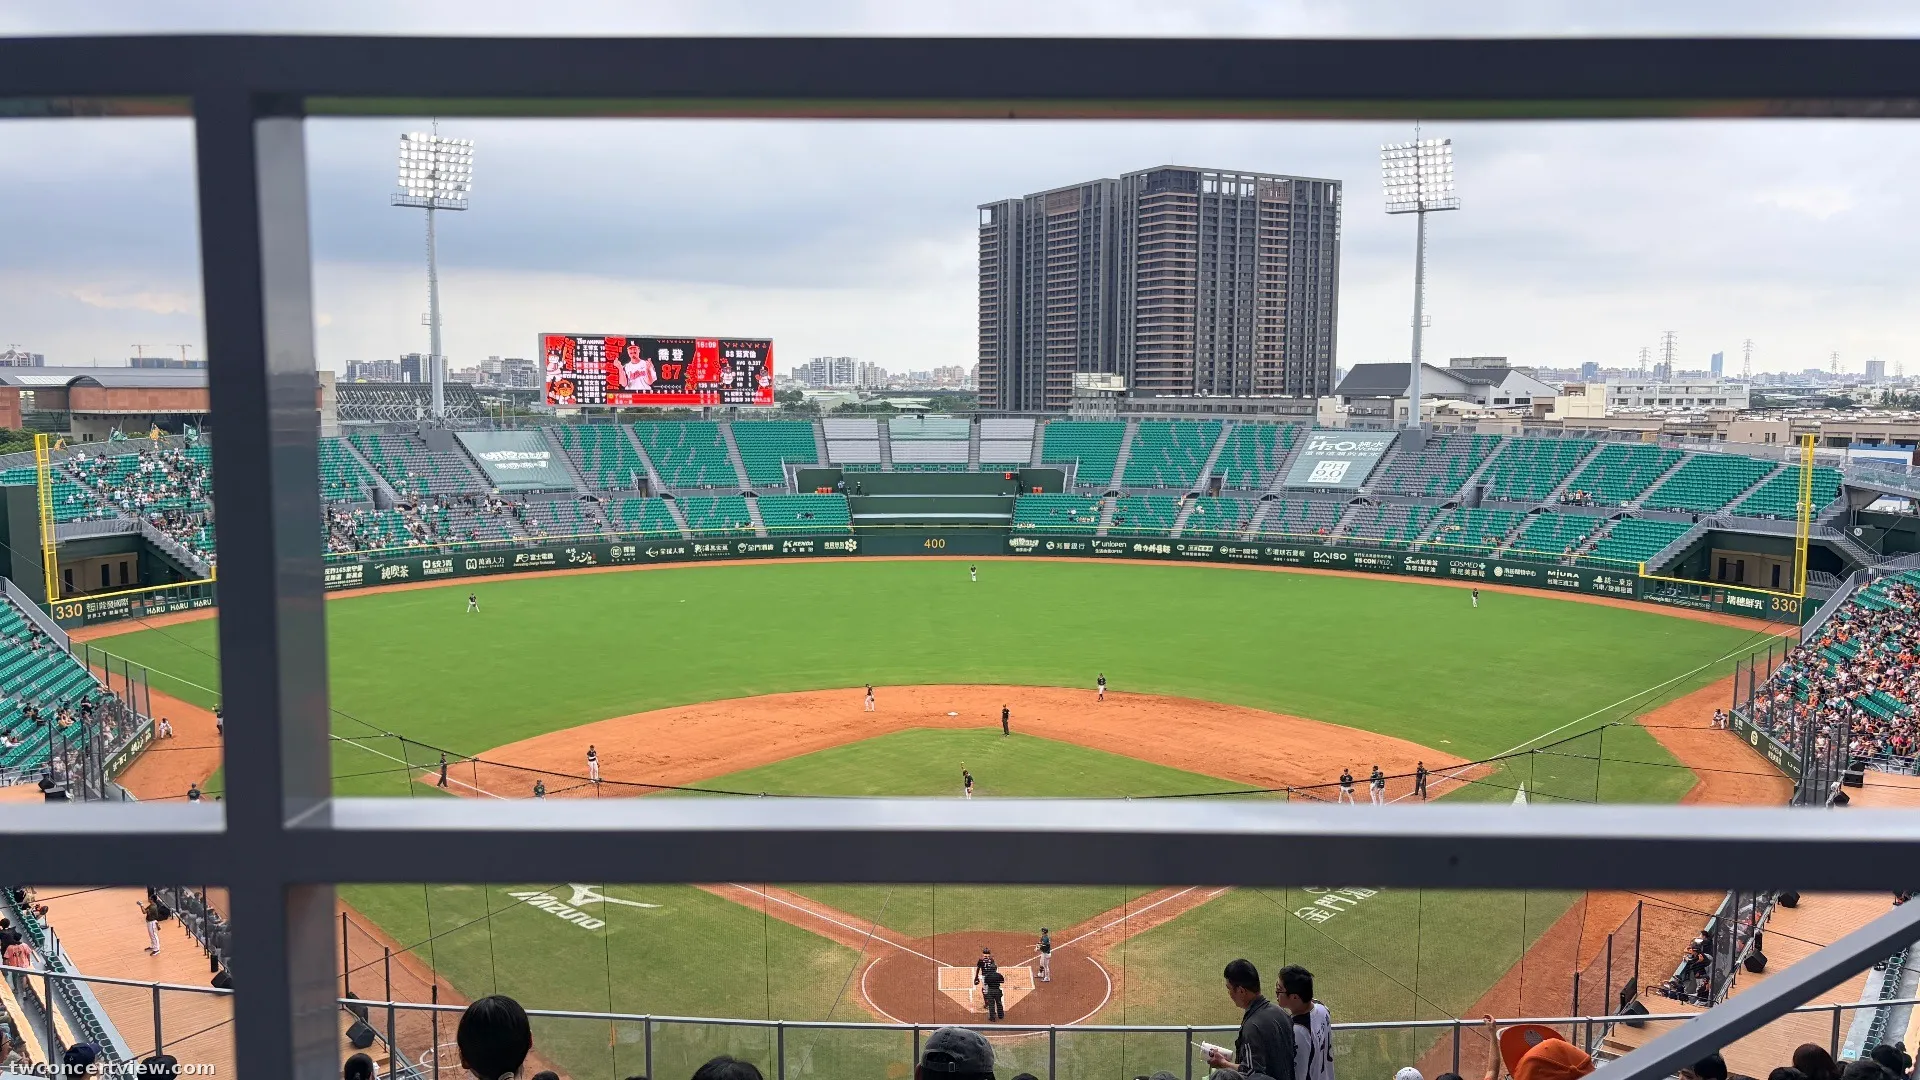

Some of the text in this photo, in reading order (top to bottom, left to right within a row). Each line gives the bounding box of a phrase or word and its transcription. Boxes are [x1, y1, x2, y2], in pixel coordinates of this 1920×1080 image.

[697, 341, 717, 349] 16:09
[661, 363, 682, 380] 87
[1315, 470, 1341, 478] 9.0
[924, 539, 945, 549] 400
[530, 552, 554, 561] 富士電機
[1313, 551, 1347, 561] DAISO
[1449, 560, 1479, 569] COSMED
[381, 565, 409, 580] 純喫茶
[1449, 568, 1486, 577] 康是美藥妝
[1604, 576, 1633, 587] 統一東京
[146, 598, 212, 615] HARU HARU HARU
[1726, 595, 1763, 610] 瑞穗鮮乳
[1771, 597, 1798, 613] 330
[56, 603, 83, 620] 330
